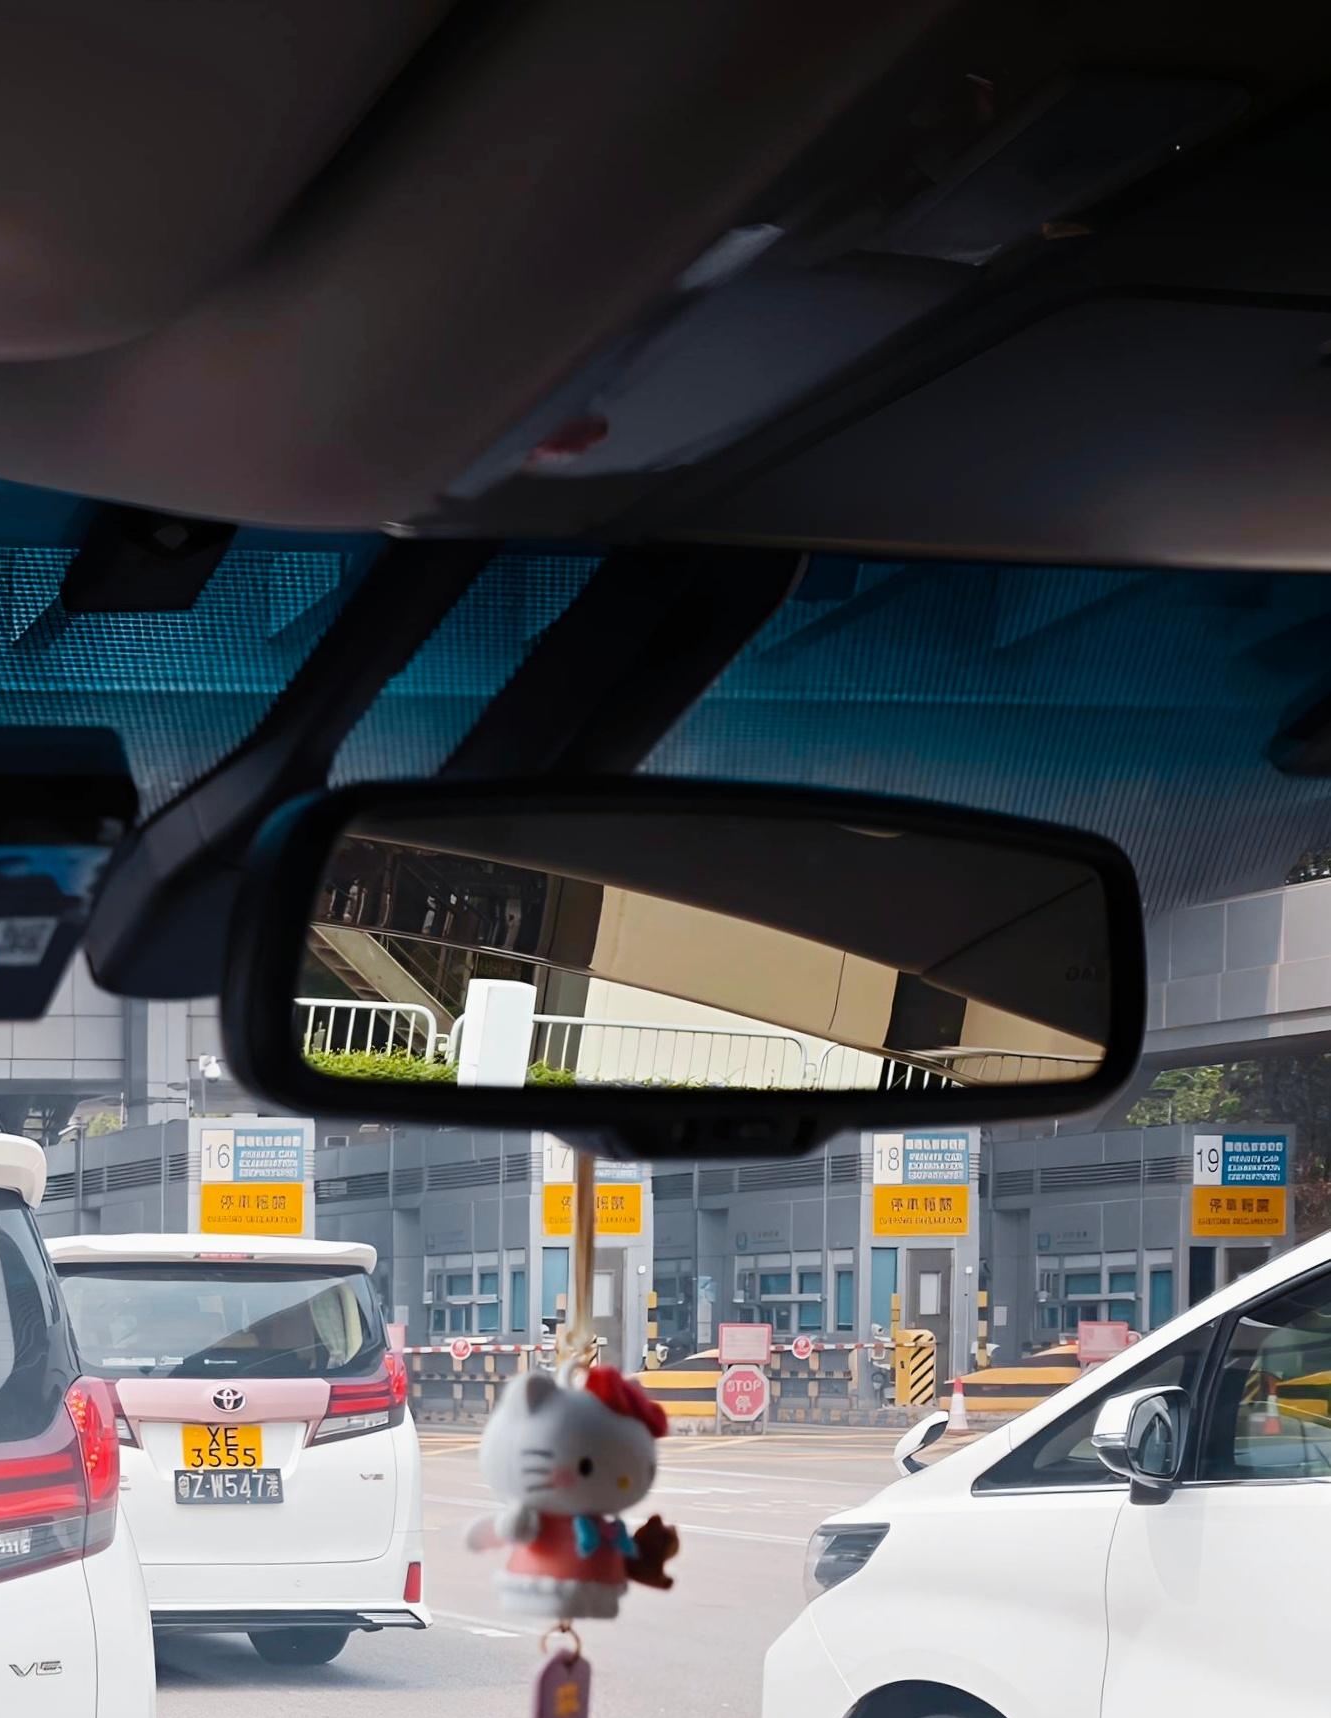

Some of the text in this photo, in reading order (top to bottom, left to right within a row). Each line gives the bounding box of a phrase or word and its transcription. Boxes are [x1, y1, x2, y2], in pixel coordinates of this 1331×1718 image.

[206, 1144, 230, 1168] 16
[547, 1144, 571, 1169] 17
[877, 1147, 899, 1171] 18
[1197, 1148, 1219, 1173] 19
[726, 1380, 762, 1393] STOP
[207, 1427, 239, 1447] XE
[191, 1448, 256, 1468] 3555
